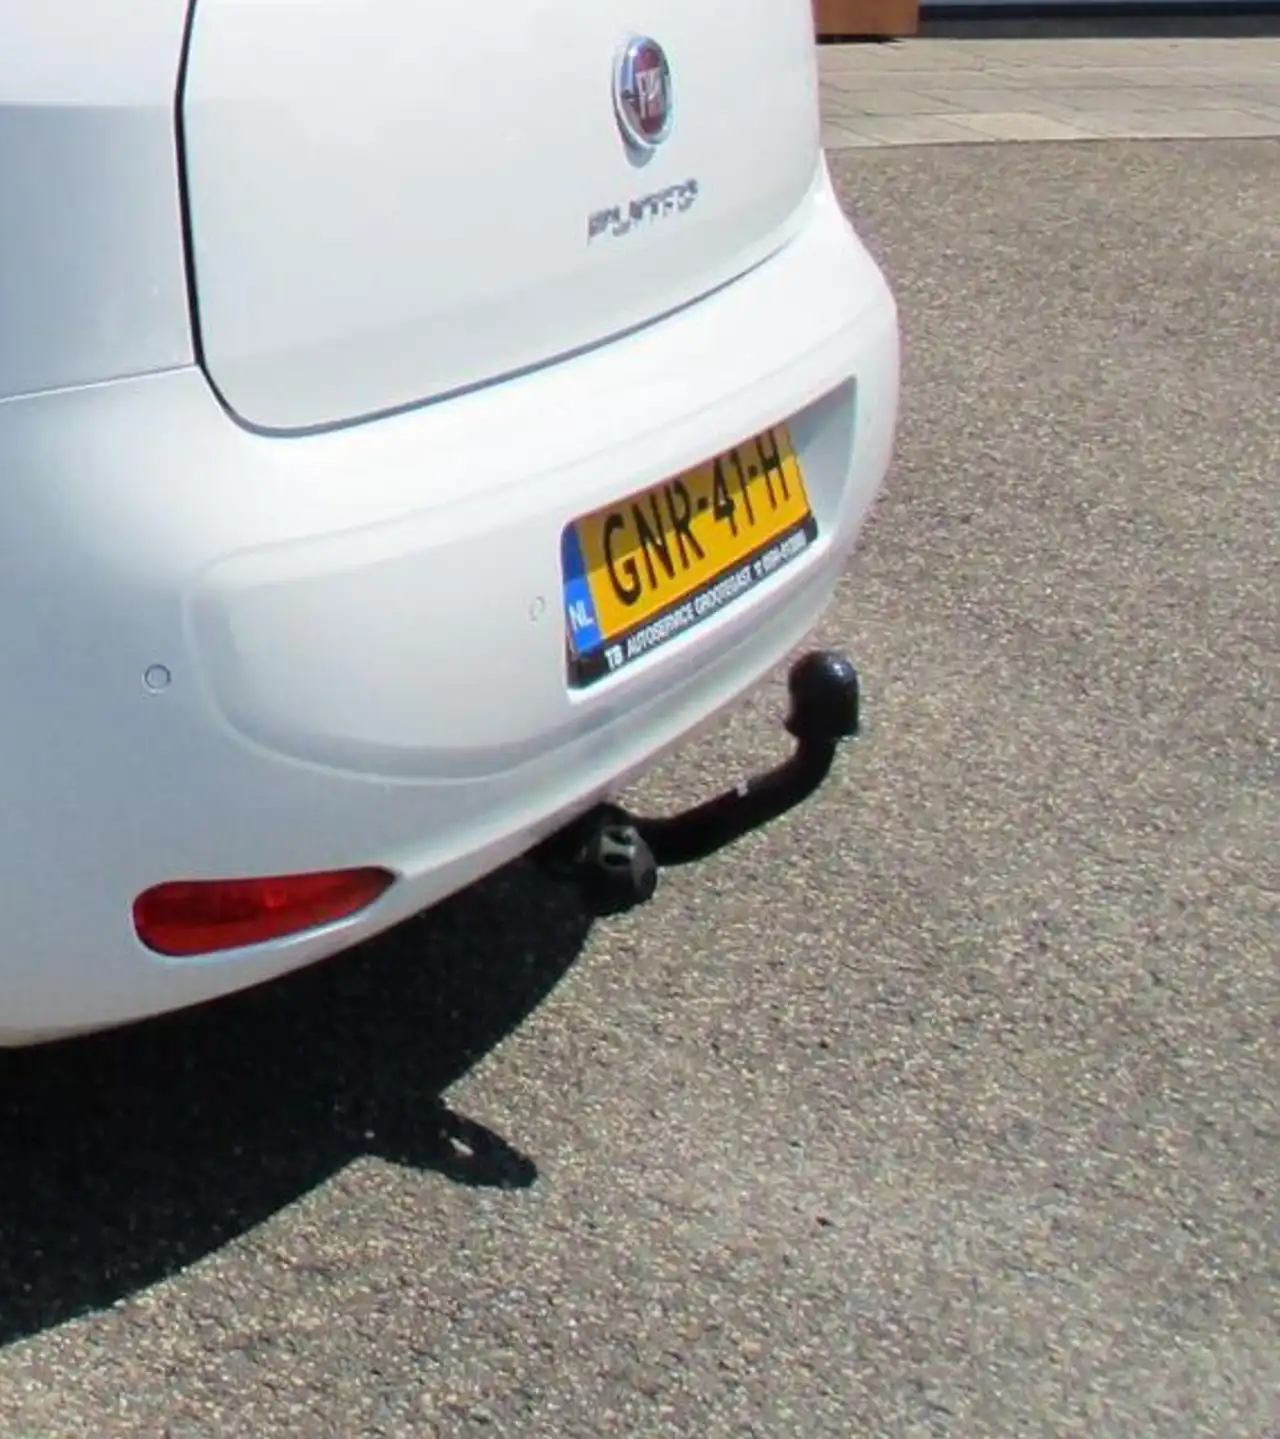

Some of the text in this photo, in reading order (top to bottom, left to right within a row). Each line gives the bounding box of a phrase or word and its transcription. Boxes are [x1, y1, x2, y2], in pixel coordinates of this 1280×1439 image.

[603, 428, 789, 606] GNR-41-H
[568, 601, 594, 636] NL
[604, 644, 624, 670] TB
